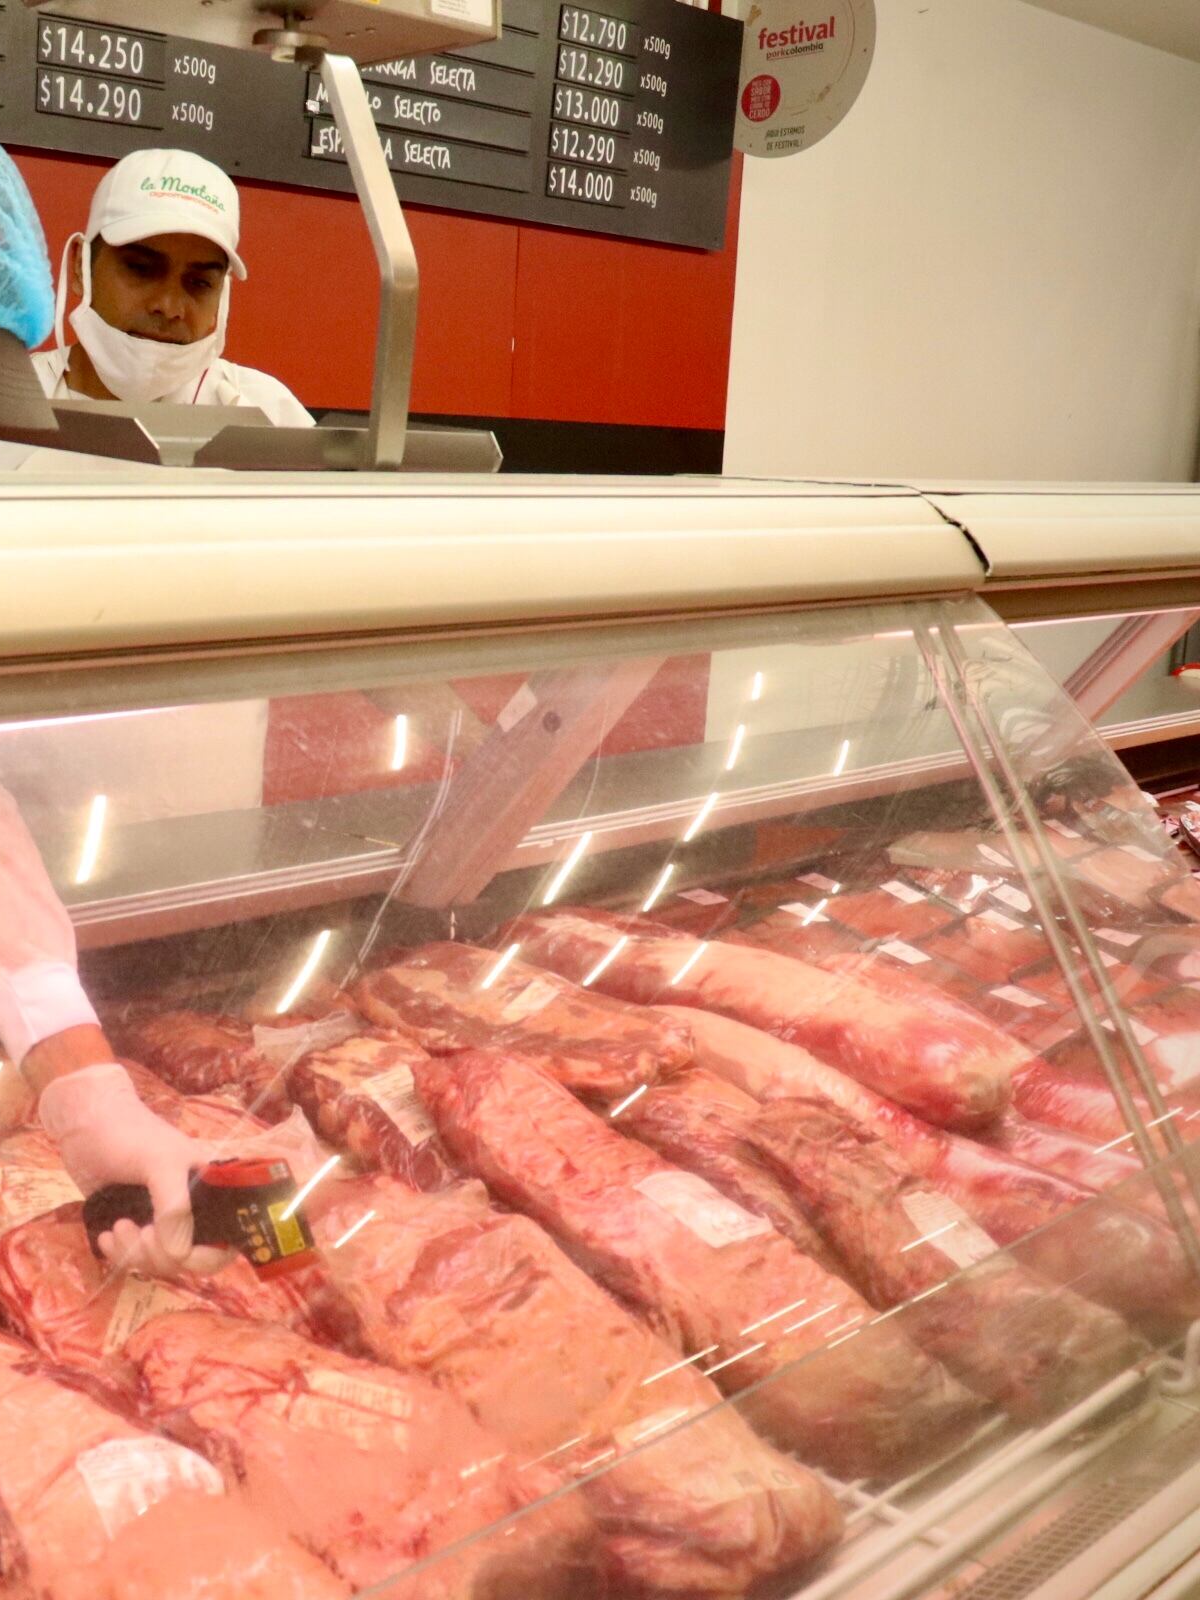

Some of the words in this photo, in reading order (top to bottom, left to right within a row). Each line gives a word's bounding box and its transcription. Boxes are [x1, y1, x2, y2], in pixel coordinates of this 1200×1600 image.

[561, 10, 627, 50] $12.790
[644, 35, 671, 60] x500g
[757, 15, 836, 50] festival
[41, 25, 144, 74] $14.250
[174, 56, 216, 85] x500g
[430, 61, 476, 92] SELECTA
[559, 49, 624, 89] $12.290
[640, 73, 667, 97] x500g
[40, 74, 142, 121] $14.290
[171, 102, 214, 131] x500g
[394, 94, 441, 125] SELECTO
[555, 89, 619, 127] $13.000
[636, 111, 664, 135] x500g
[404, 139, 451, 170] SELECTA
[552, 128, 615, 164] $12.290
[633, 148, 661, 172] x500g
[549, 166, 613, 202] $14.000
[630, 186, 658, 209] x500g
